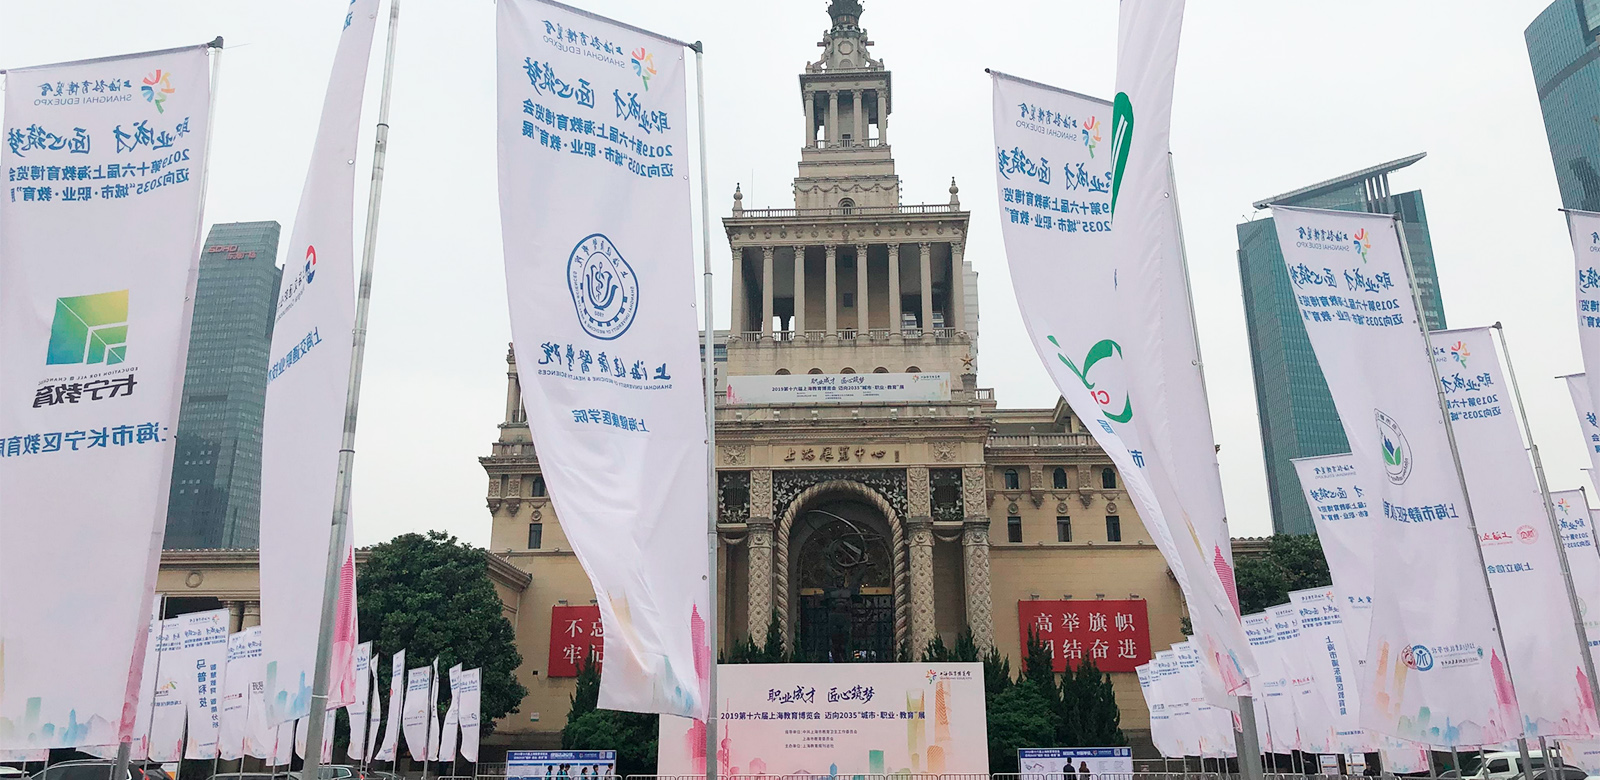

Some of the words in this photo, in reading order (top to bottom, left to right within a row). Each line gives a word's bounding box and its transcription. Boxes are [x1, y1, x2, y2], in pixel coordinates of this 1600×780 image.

[1034, 611, 1136, 633] 高举旗帜
[767, 685, 816, 704] 职业成才
[827, 684, 875, 705] 匠心筑梦
[720, 711, 821, 721] 2019第十六届上海教育博览会
